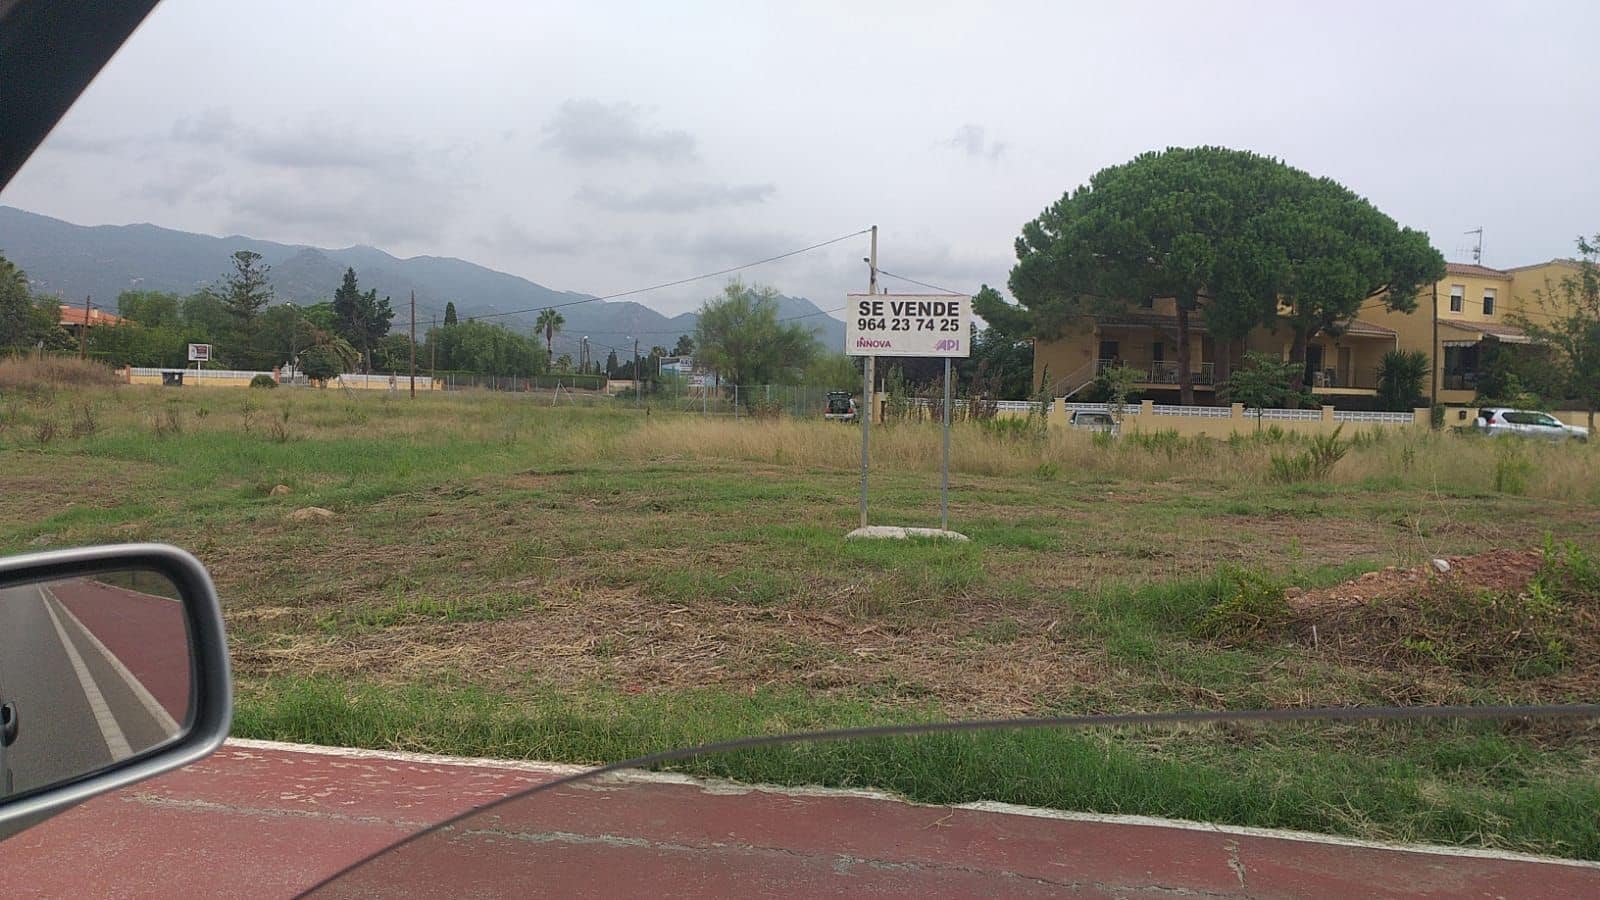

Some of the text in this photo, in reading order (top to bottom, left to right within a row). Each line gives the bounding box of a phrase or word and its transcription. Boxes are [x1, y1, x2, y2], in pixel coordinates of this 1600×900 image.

[859, 301, 960, 317] SE VENDE
[857, 318, 959, 332] 964 23 74 25
